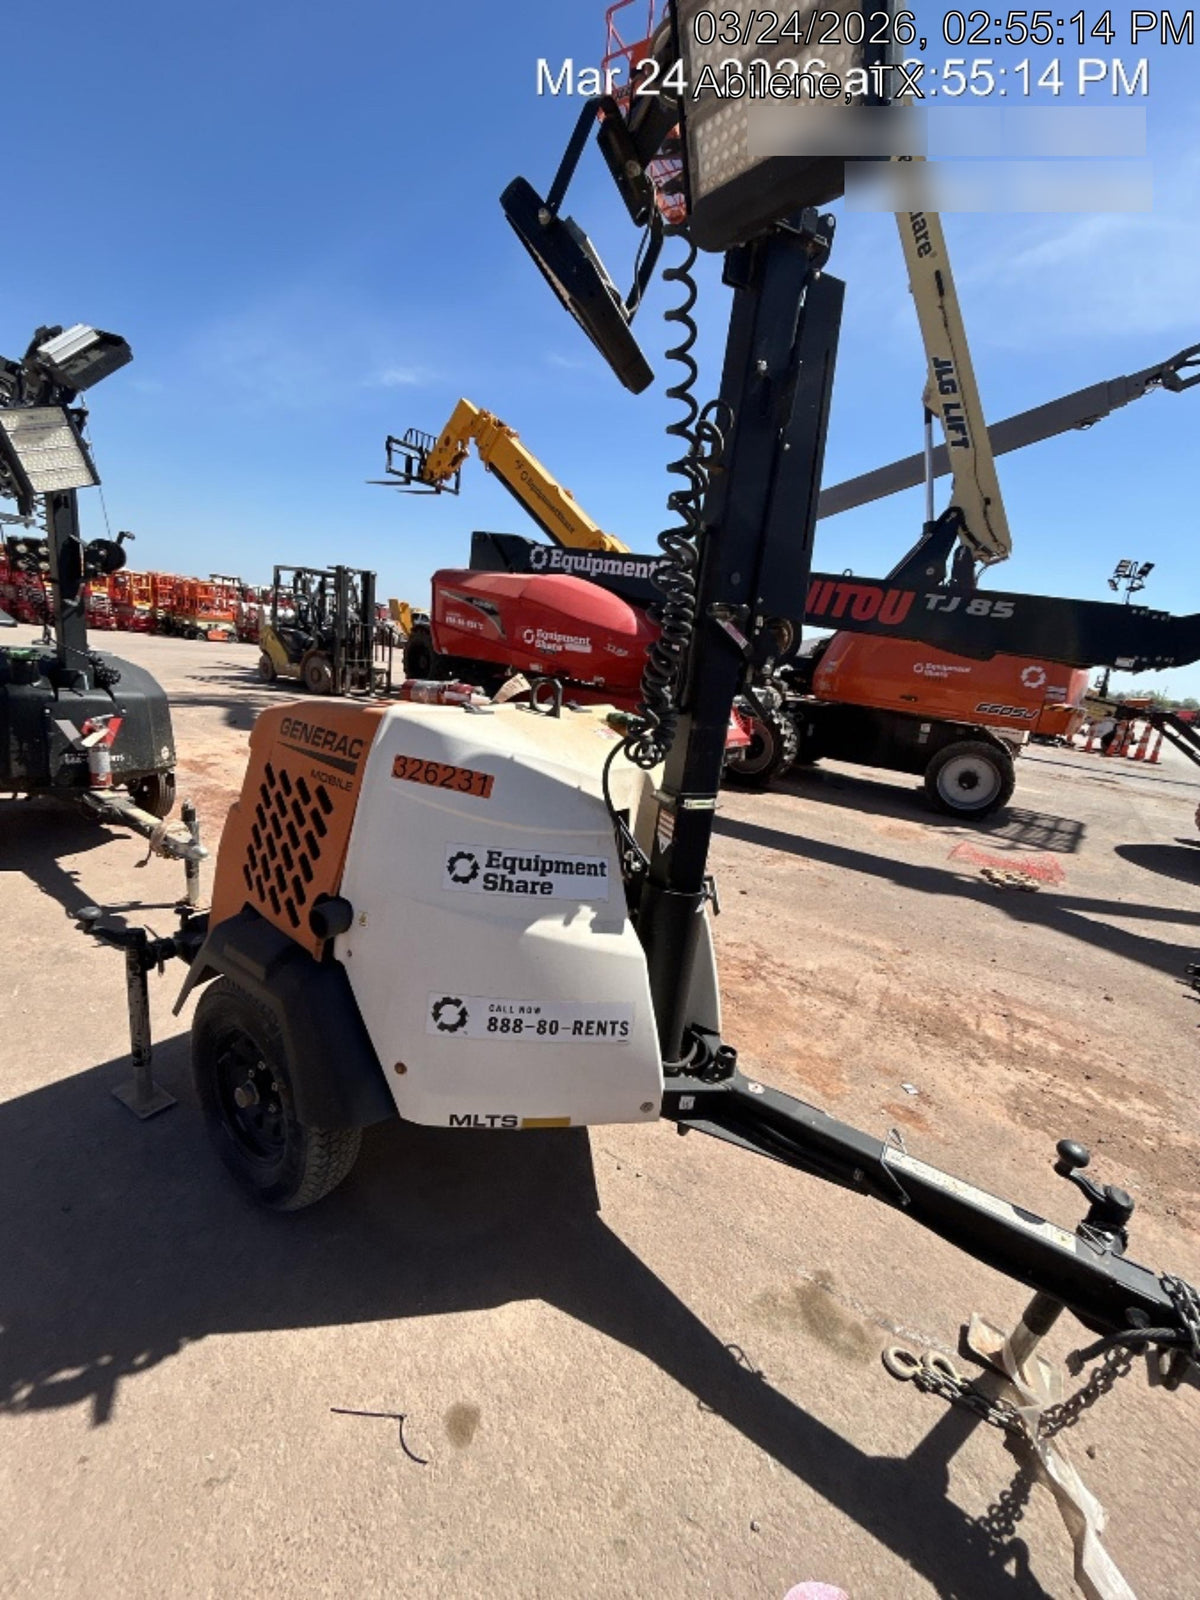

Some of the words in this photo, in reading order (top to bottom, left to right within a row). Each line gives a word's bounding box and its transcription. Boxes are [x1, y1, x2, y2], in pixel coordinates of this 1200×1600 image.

[931, 356, 957, 396] JLG
[942, 401, 970, 449] LIFT
[924, 593, 962, 612] TJ
[965, 598, 1016, 618] 85
[280, 717, 364, 759] GENERAC
[310, 769, 354, 791] MOBILE
[393, 757, 491, 796] 326231
[485, 850, 607, 880] Equipment
[482, 873, 553, 896] Share
[488, 1004, 515, 1014] CALL
[518, 1006, 542, 1015] NOW
[486, 1016, 629, 1037] 888-80-RENTS
[449, 1114, 518, 1129] MLTS
